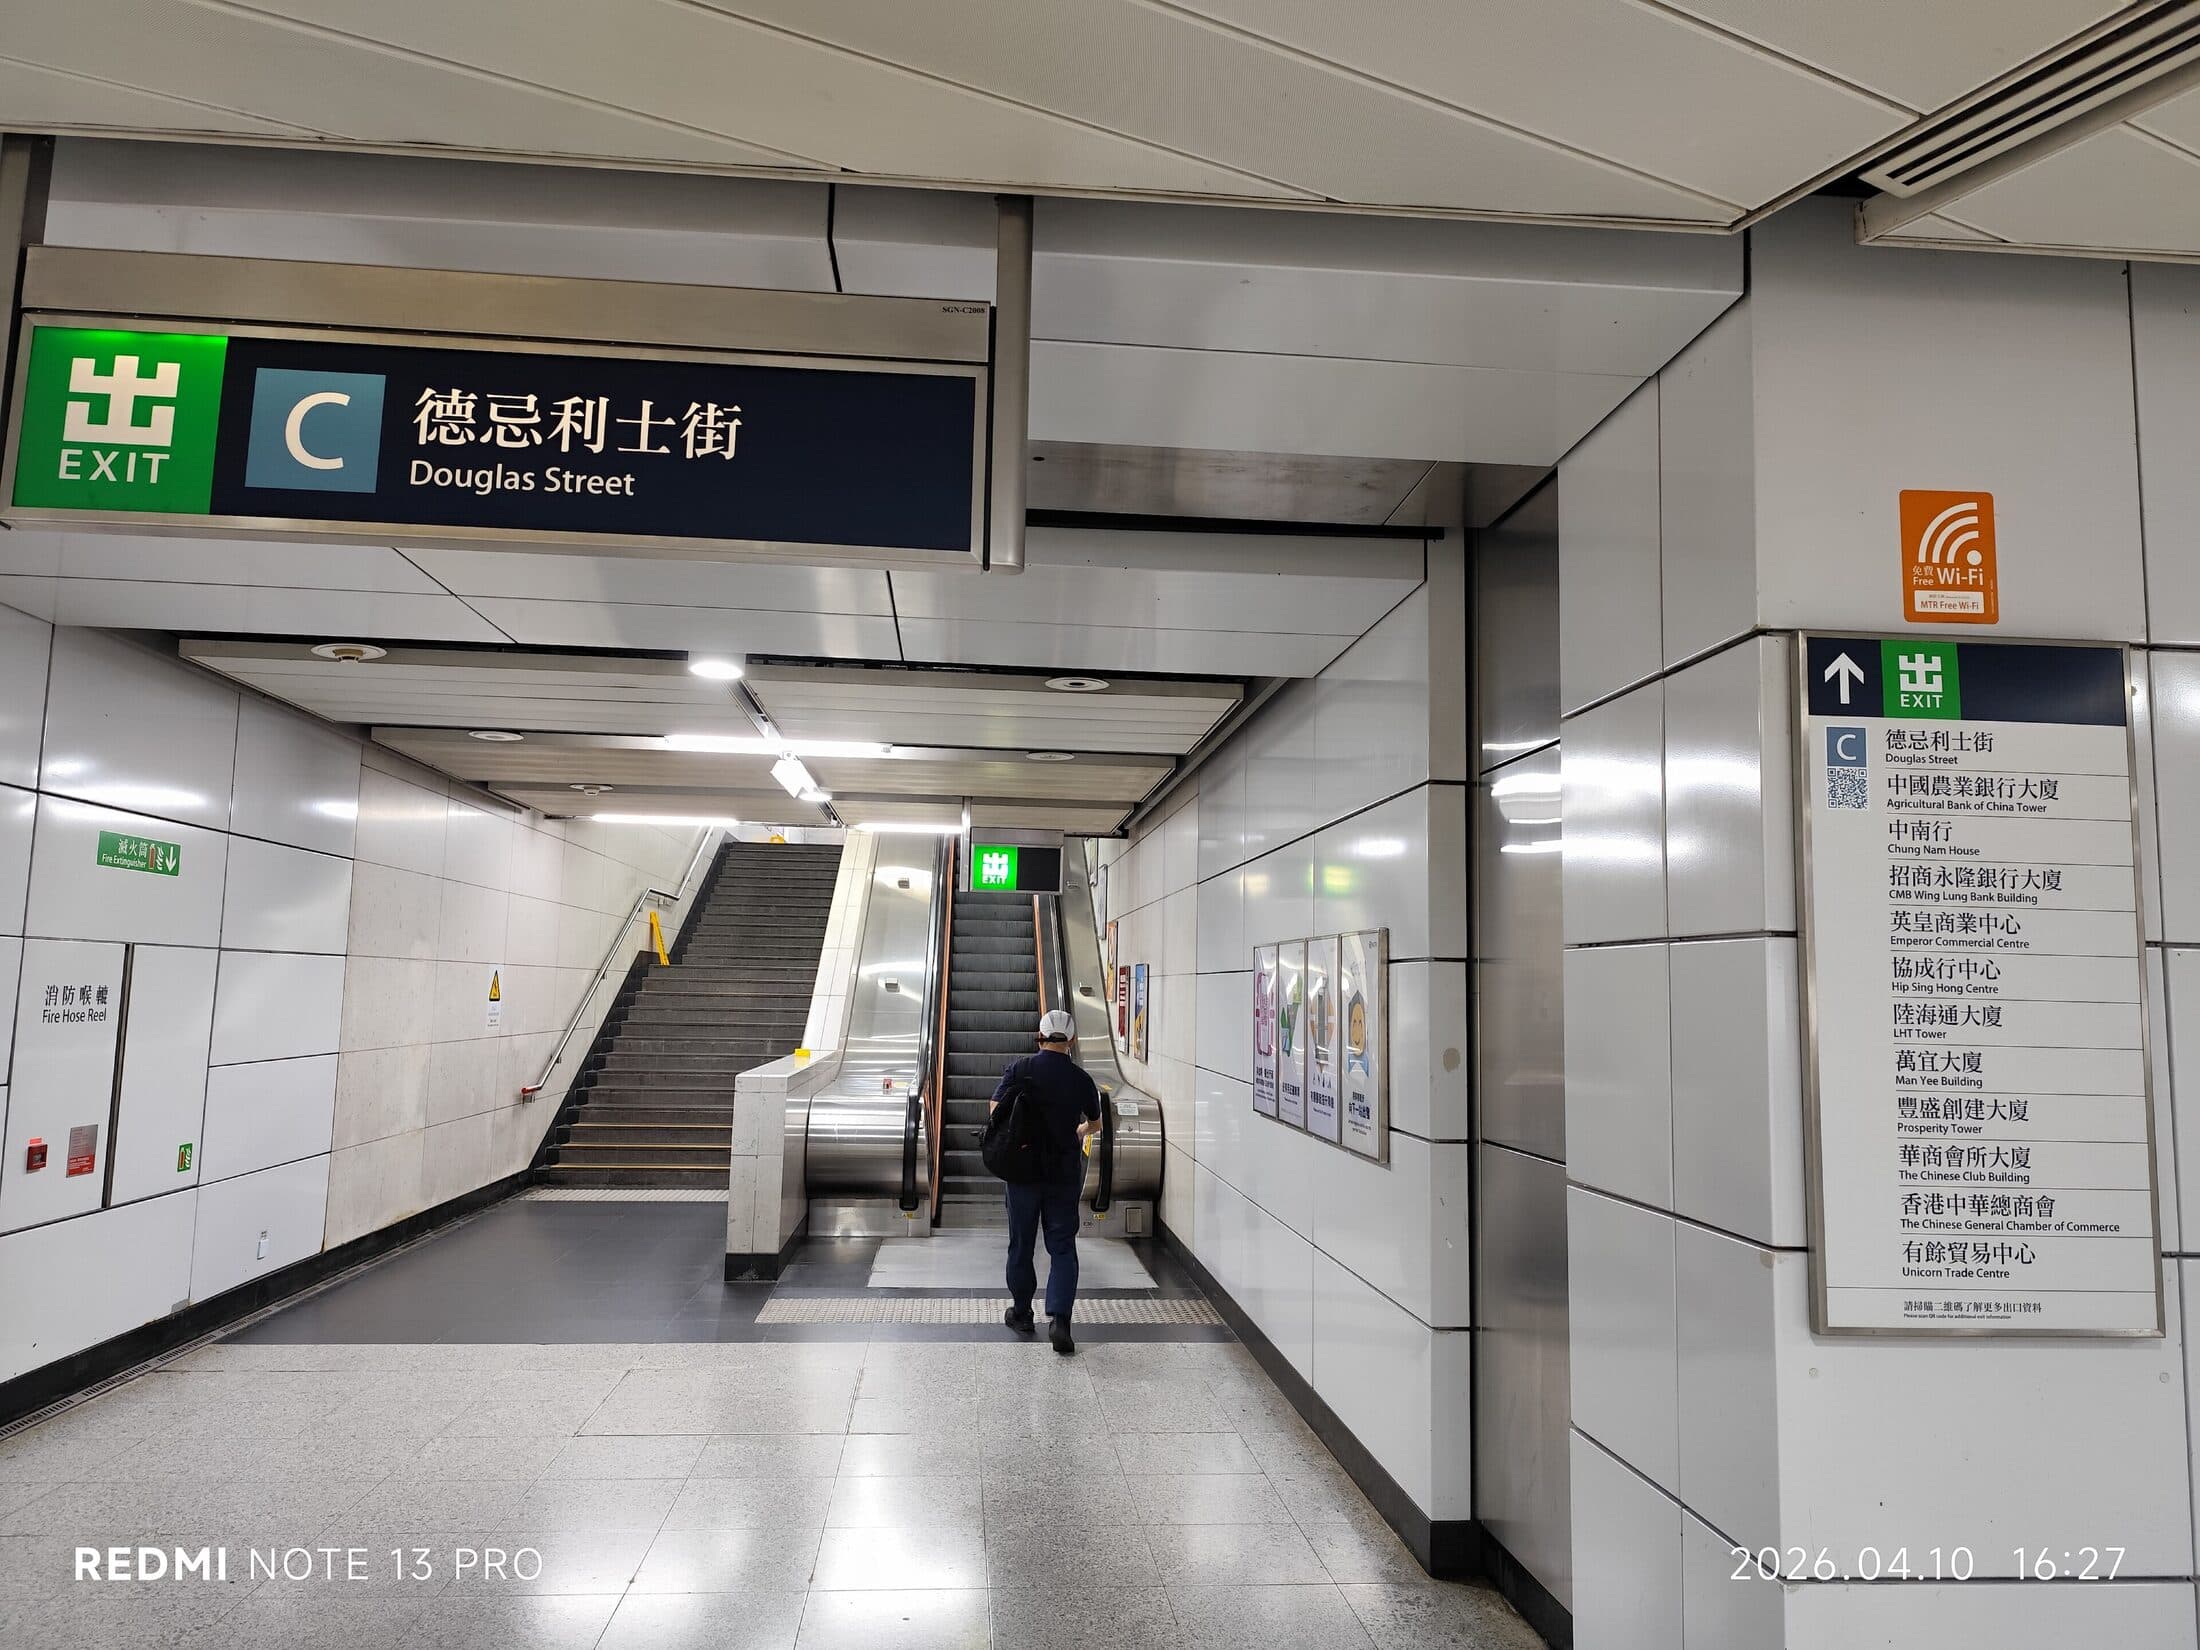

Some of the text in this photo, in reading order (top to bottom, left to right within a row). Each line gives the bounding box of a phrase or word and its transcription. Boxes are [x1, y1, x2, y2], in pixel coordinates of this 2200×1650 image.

[286, 392, 350, 470] C
[413, 388, 741, 460] 德忌利士街
[59, 449, 169, 484] EXIT
[411, 460, 635, 496] Douglas Street
[1913, 567, 1983, 586] Free Wi-Fi
[1921, 601, 1978, 610] MTR Free Wi-Fi
[1901, 694, 1943, 708] EXIT
[1837, 734, 1856, 760] C
[1887, 729, 1993, 752] 德忌利士街
[1886, 753, 1957, 765] Douglas Street
[1888, 774, 2058, 800] 中國農業銀行大廈
[1887, 799, 2046, 813] Agricultural Bank of China Tower
[1890, 819, 1952, 842] 中南行
[1888, 844, 1979, 856] Chung Nam House
[102, 853, 147, 868] Fire Extinguisher
[982, 875, 1007, 884] EXIT
[1890, 865, 2061, 891] 招商永隆銀行大廈
[1889, 890, 2037, 906] CMB Wing Lung Bank Building
[1891, 911, 2020, 935] 英皇商業中心
[1891, 936, 2029, 949] Emperor Commercial Centre
[1894, 957, 2000, 980] 協成行中心
[1892, 982, 1998, 995] Hip Sing Hong Centre
[43, 1008, 106, 1023] Fire Hose Reel
[1894, 1003, 2002, 1027] 陸海通大廈
[1894, 1028, 1946, 1039] LHT Tower
[1896, 1050, 1982, 1073] 萬宜大廈
[1896, 1076, 1982, 1089] Man Yee Building
[1899, 1097, 2028, 1121] 豐盛創建大廈
[1898, 1123, 1982, 1136] Prosperity Tower
[1900, 1144, 2031, 1169] 華商會所大廈
[1899, 1170, 2029, 1184] The Chinese Club Building
[1902, 1193, 2055, 1218] 香港中華總商會
[1900, 1219, 2119, 1232] The Chinese General Chamber of Commerce
[1903, 1241, 2035, 1265] 有餘貿易中心
[1903, 1267, 2009, 1278] Unicorn Trade Centre
